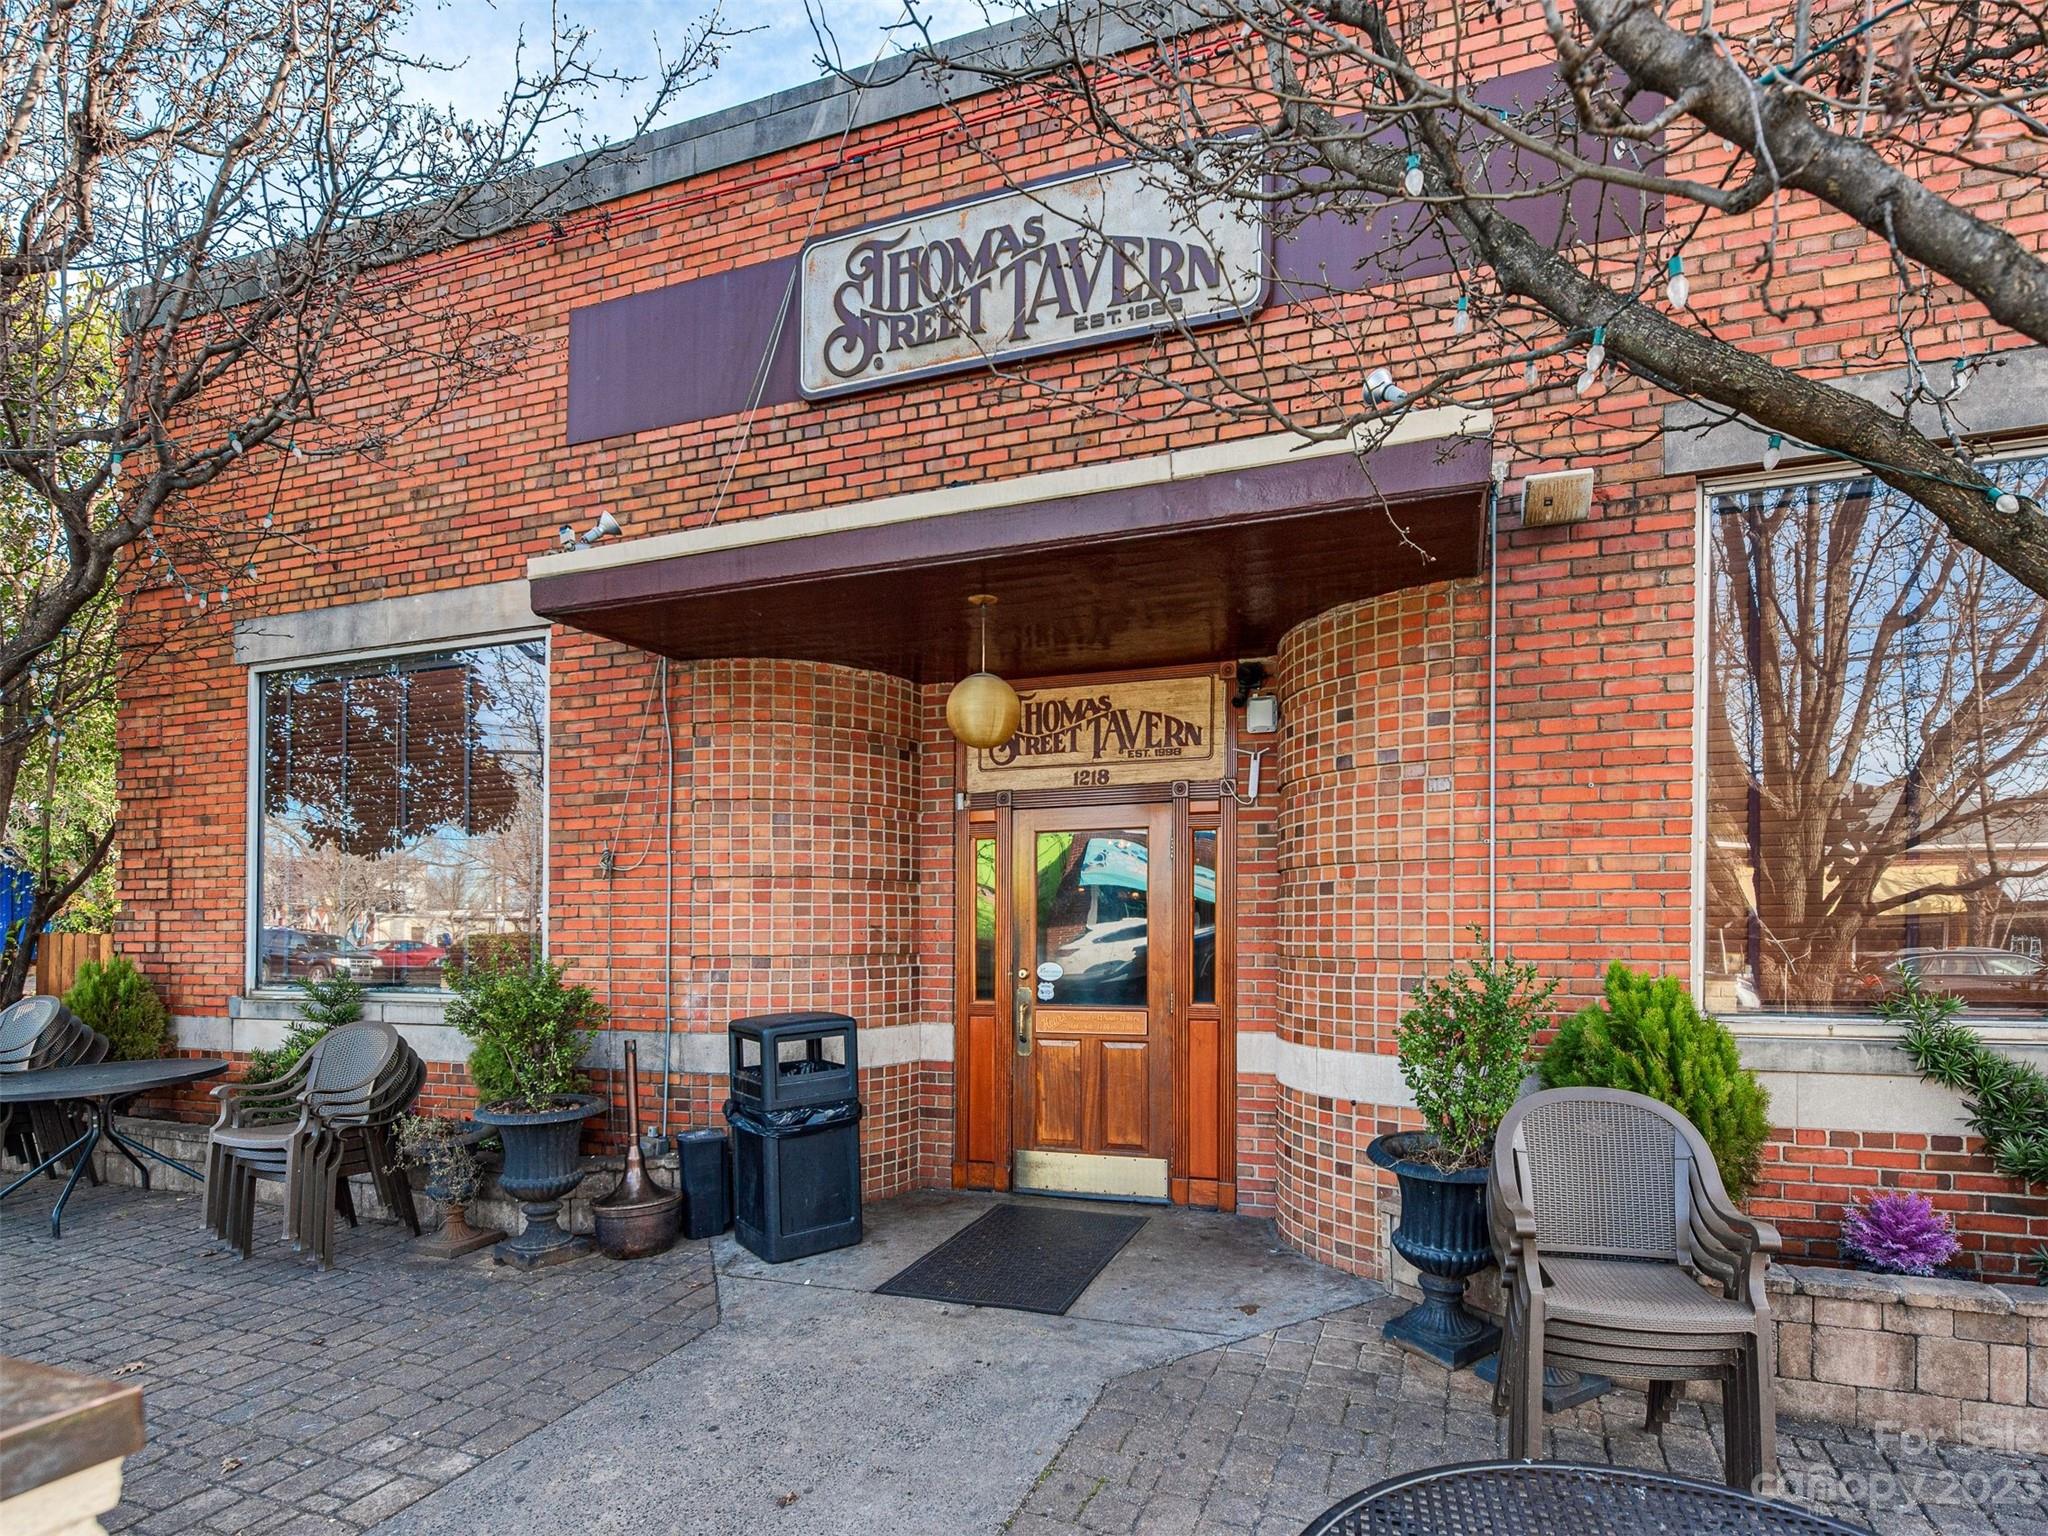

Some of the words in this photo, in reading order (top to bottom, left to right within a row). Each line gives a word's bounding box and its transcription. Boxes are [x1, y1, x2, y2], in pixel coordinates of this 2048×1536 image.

[845, 214, 1046, 313] THOMAS
[823, 277, 992, 378] STREET
[1000, 233, 1222, 343] TAVERN
[1073, 310, 1122, 333] EST.
[1085, 708, 1204, 759] TAVERN
[1127, 749, 1151, 759] EST.
[1073, 769, 1110, 786] 1218
